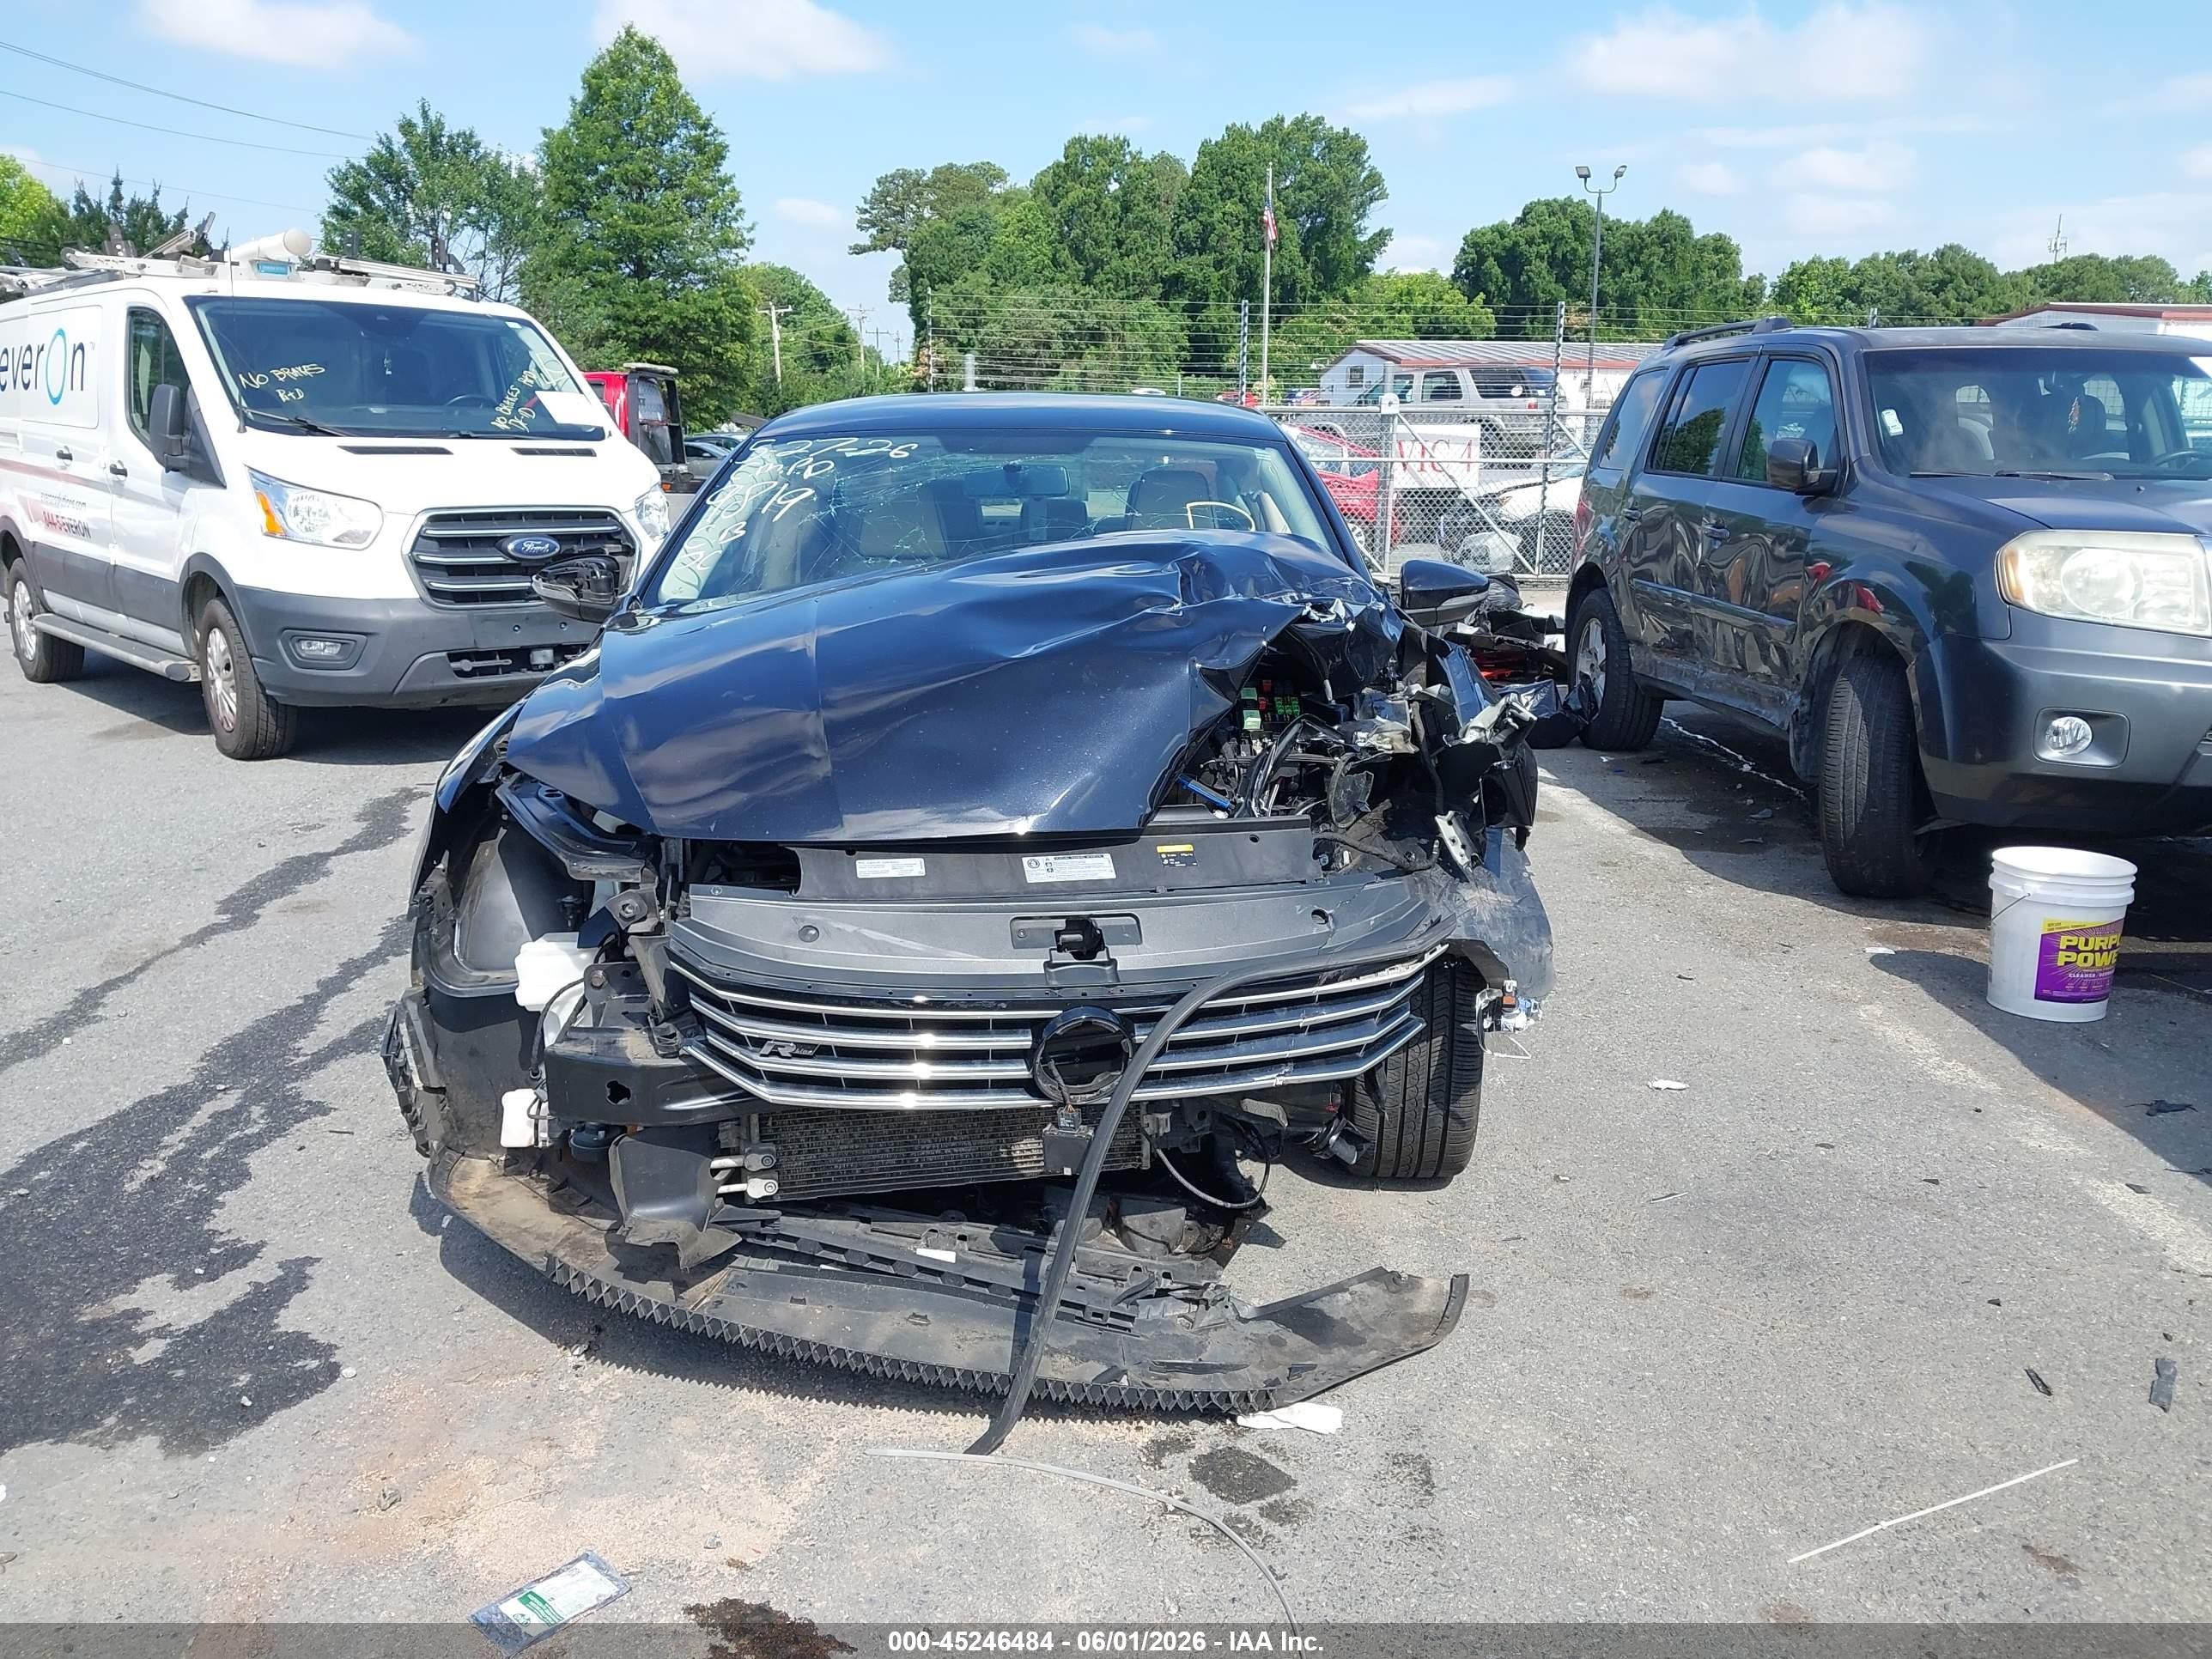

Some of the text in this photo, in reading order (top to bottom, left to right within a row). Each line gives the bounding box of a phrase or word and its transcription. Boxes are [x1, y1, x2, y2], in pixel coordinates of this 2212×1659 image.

[239, 363, 325, 389] NO BRAKES
[495, 384, 520, 416] BRAKES
[490, 416, 511, 430] NO
[736, 437, 919, 465] 5-27-26
[1397, 439, 1450, 473] VIC
[522, 540, 550, 553] Ford
